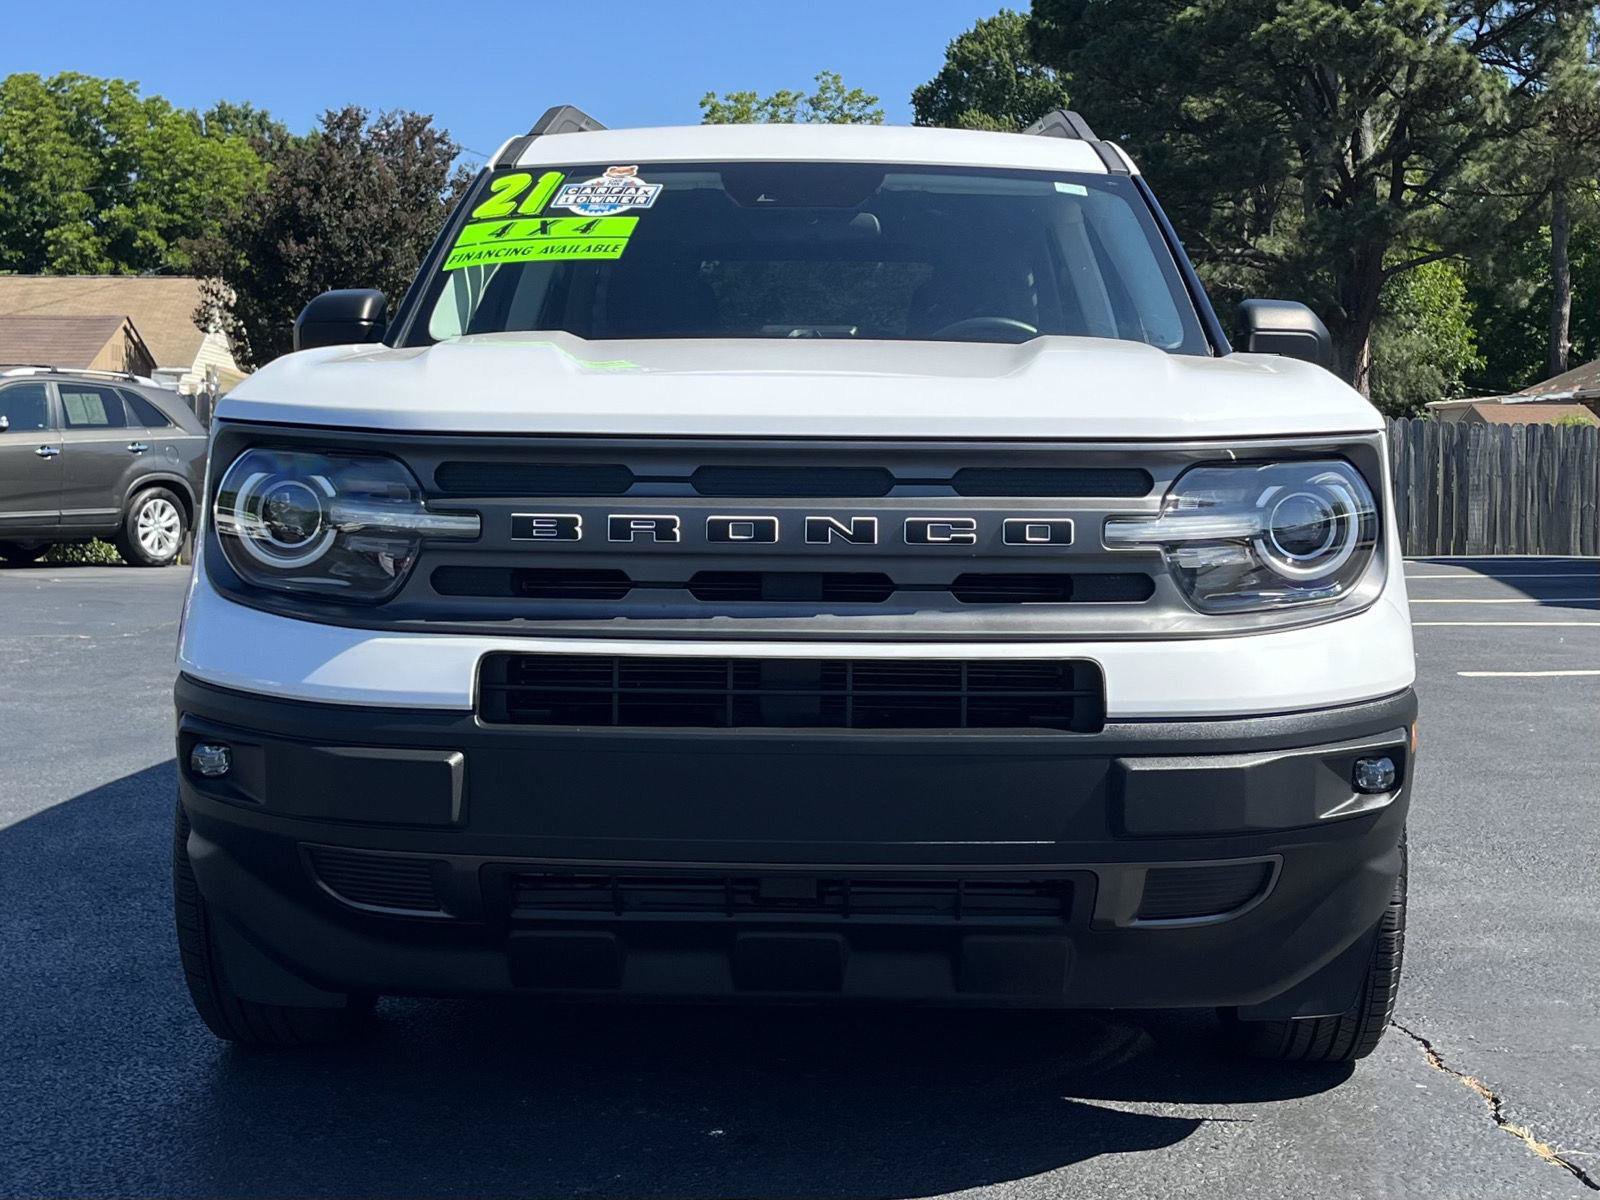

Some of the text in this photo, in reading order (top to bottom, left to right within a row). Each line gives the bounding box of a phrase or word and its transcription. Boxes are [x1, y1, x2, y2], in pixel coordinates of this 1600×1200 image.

[472, 171, 565, 219] 21
[566, 186, 653, 195] CARFAX
[575, 195, 649, 204] OWNER
[488, 222, 517, 239] 4
[571, 218, 601, 234] 4
[448, 243, 622, 265] FINANCING AVAILABLE
[510, 513, 1075, 546] BRONCO
